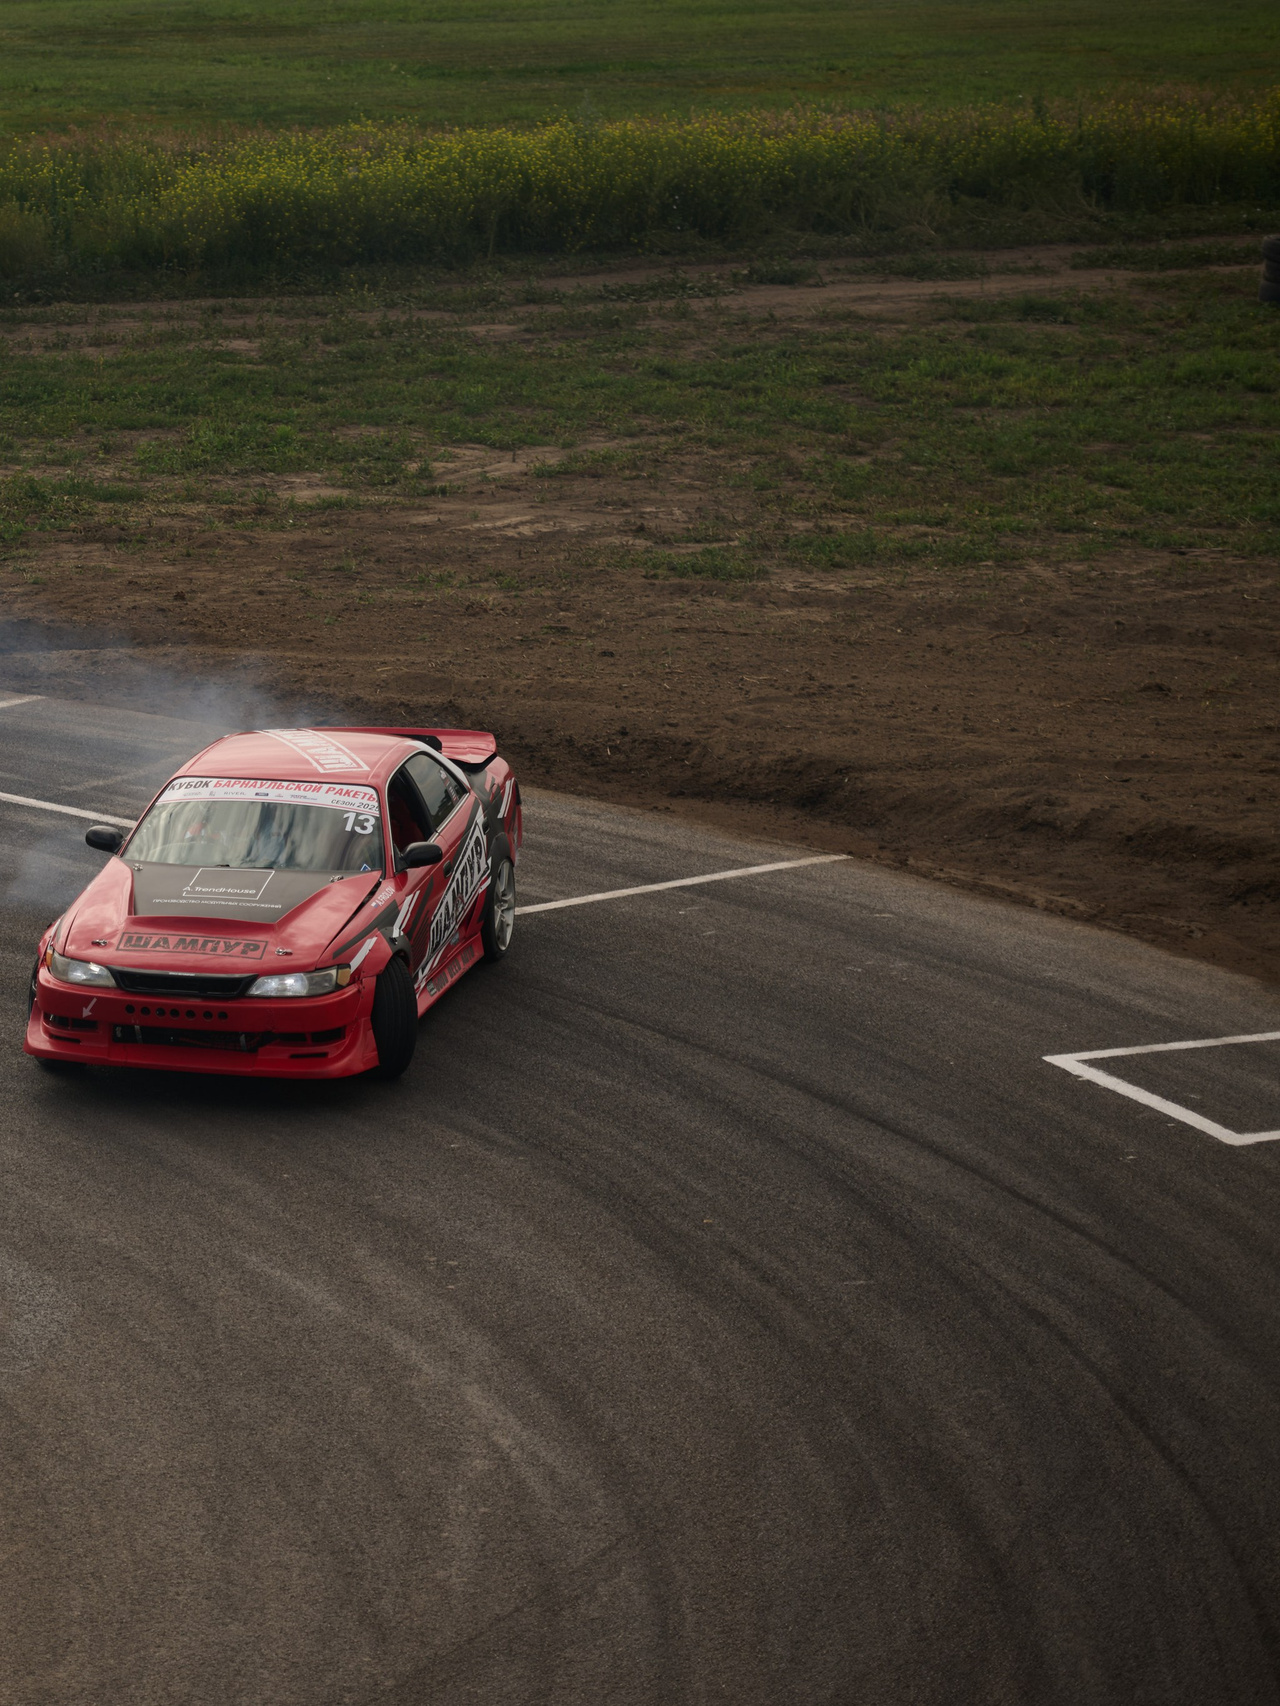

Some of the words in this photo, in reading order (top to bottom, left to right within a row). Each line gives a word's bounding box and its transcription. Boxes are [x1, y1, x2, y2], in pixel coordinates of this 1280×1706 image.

[169, 780, 212, 791] КУБОК
[213, 779, 322, 793] БАРНАУЛЬСКОЙ
[325, 786, 380, 803] РАКЕТЫ
[331, 798, 356, 807] СЕЗОН
[342, 811, 376, 835] 13
[194, 886, 257, 895] TrendHouse
[123, 935, 262, 955] ШАМПУР
